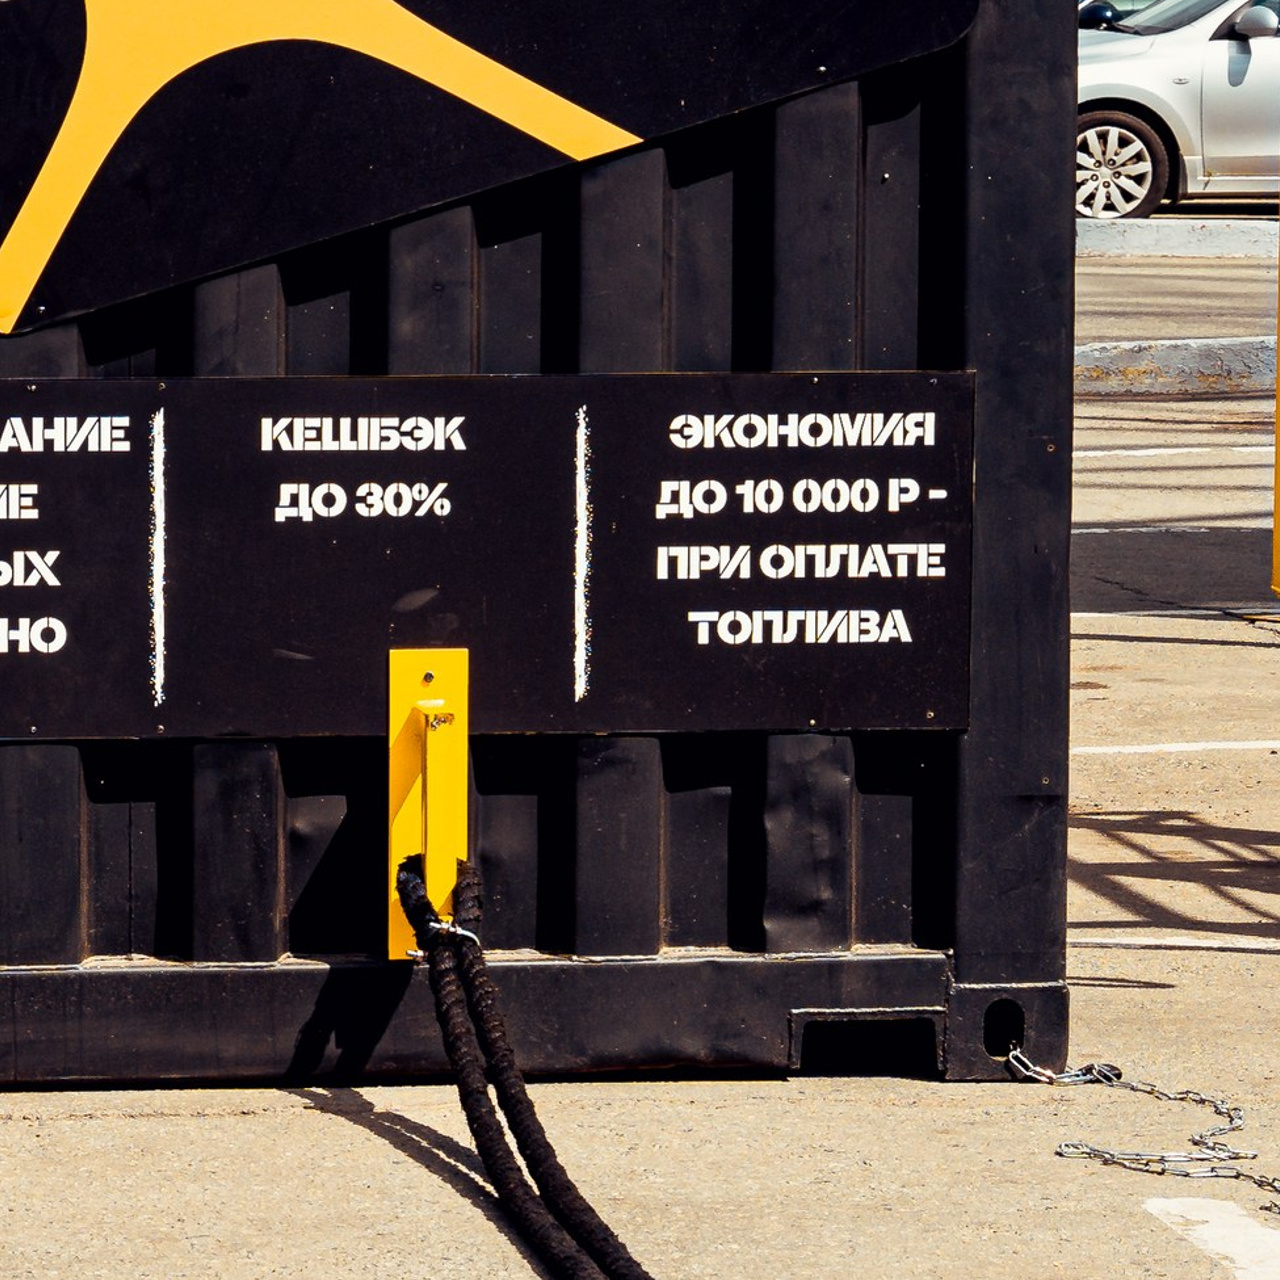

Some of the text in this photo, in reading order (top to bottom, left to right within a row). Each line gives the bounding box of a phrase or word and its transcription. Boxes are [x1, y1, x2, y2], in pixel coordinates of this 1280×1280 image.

[261, 416, 467, 451] КЕШБЭК
[669, 412, 936, 449] ЭКОНОМИЯ
[275, 482, 452, 522] ДО 30%
[656, 480, 727, 519] ДО
[736, 479, 784, 514] 10
[793, 478, 880, 513] 000
[656, 544, 946, 580] ПРИ ОПЛАТЕ
[687, 609, 913, 645] ТОПЛИВА
